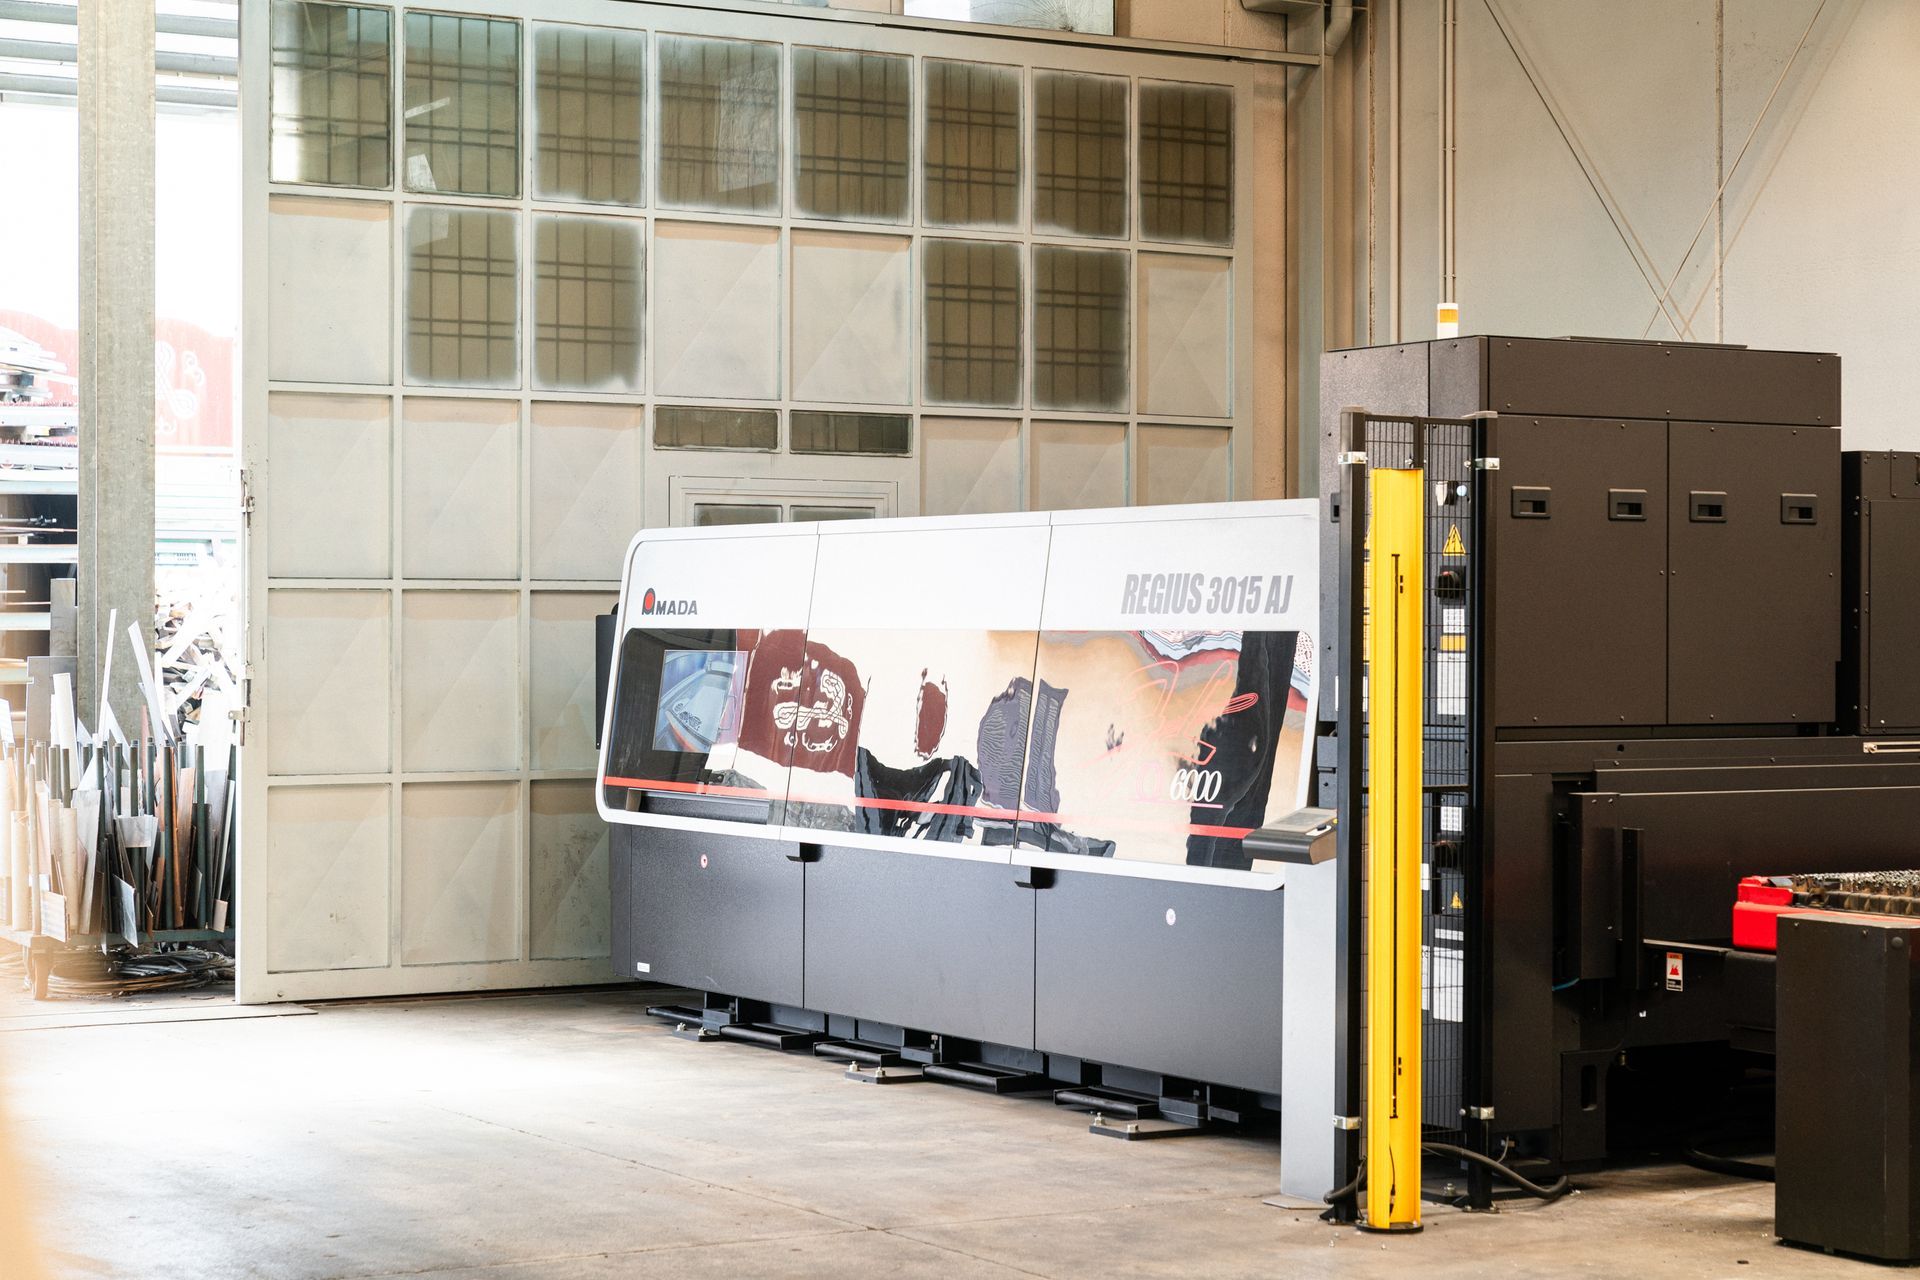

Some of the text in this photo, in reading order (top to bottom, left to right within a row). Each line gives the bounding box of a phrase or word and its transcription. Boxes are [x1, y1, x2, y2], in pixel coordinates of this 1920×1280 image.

[641, 587, 698, 616] AMADA
[1120, 573, 1293, 615] REGIUS 3015 AJ
[1170, 768, 1222, 802] 6000
